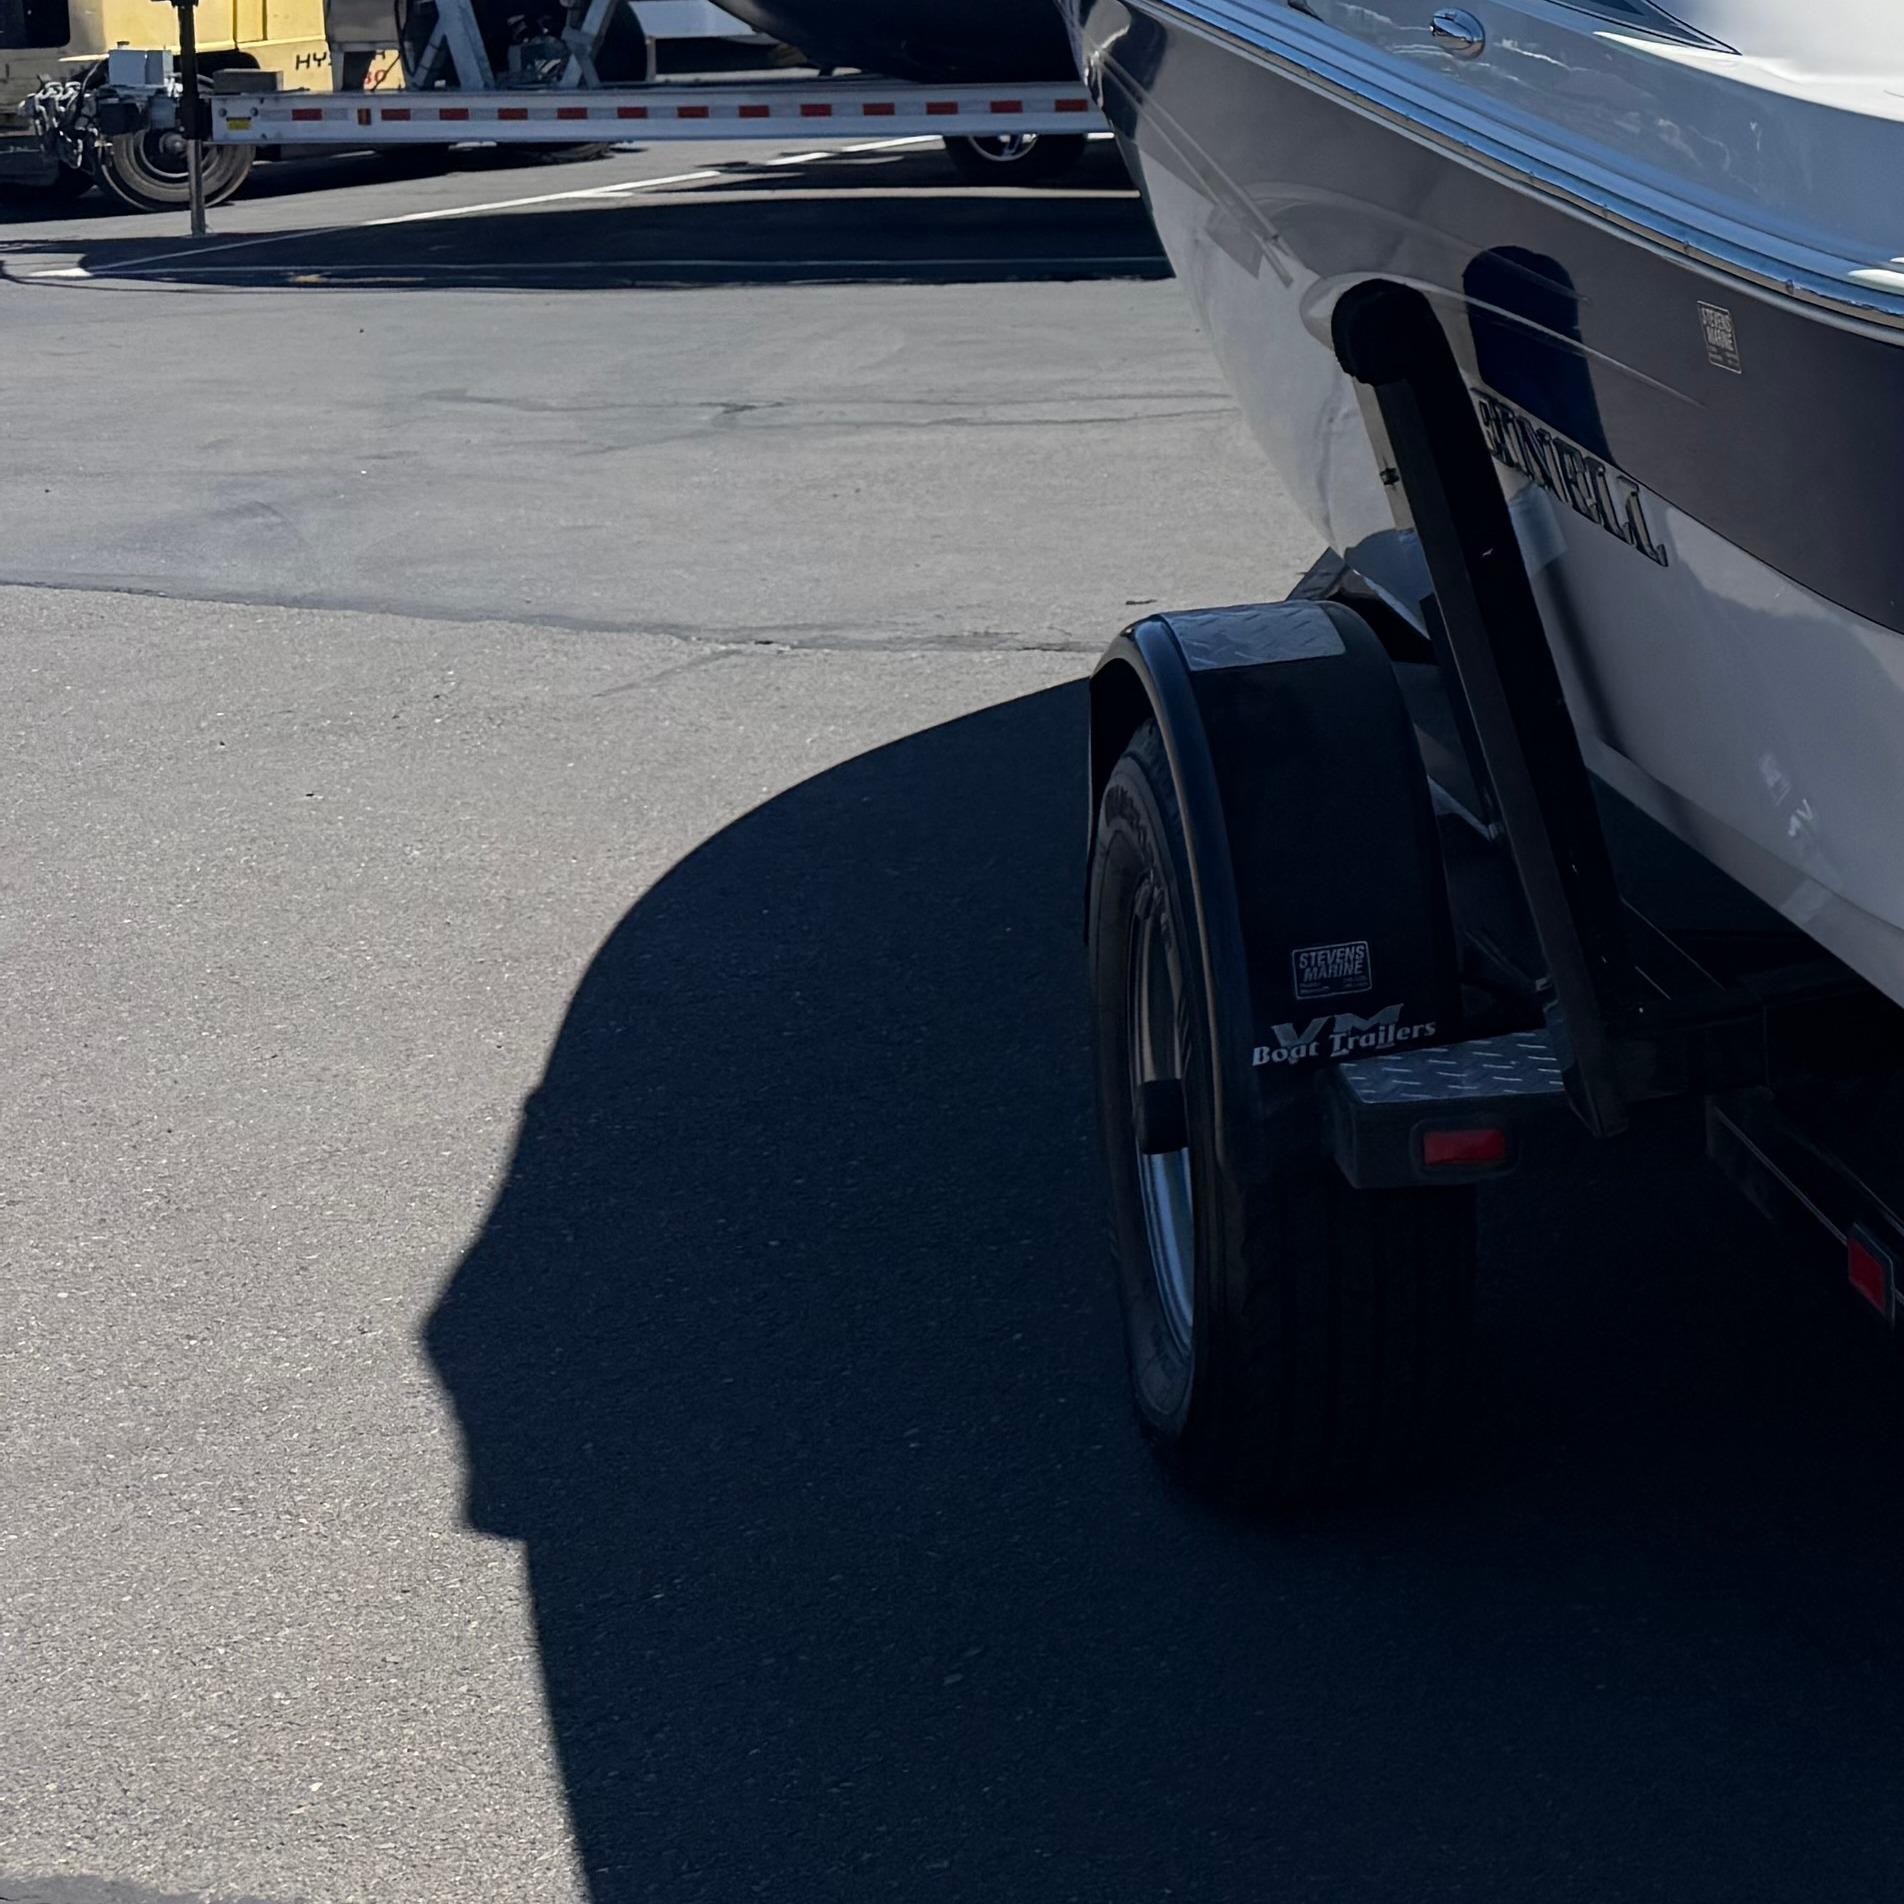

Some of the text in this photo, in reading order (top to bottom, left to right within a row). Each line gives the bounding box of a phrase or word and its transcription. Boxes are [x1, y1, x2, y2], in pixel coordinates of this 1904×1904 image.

[1471, 388, 1669, 568] EINELL
[1299, 945, 1366, 969] STEVENS
[1303, 959, 1364, 982] MARINE
[1252, 1021, 1437, 1067] Boat Trailers
